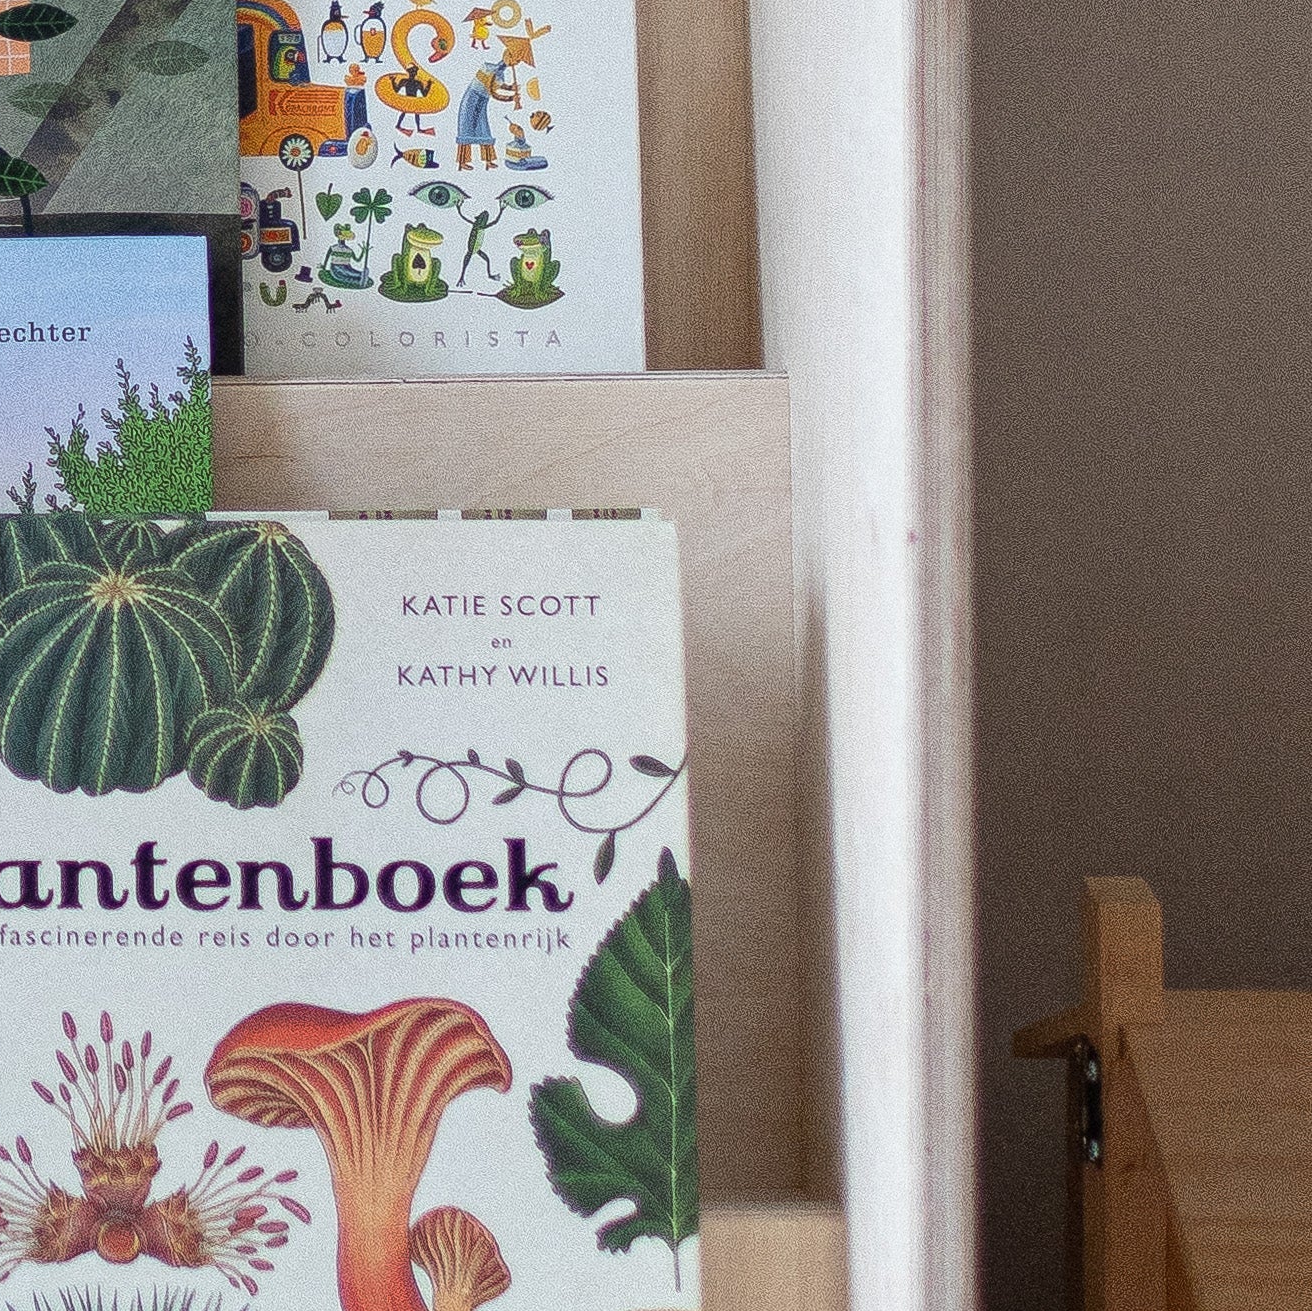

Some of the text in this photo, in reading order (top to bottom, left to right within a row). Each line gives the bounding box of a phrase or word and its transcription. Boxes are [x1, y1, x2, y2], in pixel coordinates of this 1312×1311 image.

[301, 330, 562, 347] COLORISTA
[402, 594, 601, 617] KATIE SCOTT
[490, 635, 513, 650] en
[397, 663, 611, 688] KATHY WILLIS
[197, 924, 255, 948] reis
[265, 924, 335, 950] door
[349, 926, 399, 950] het
[409, 924, 572, 955] plantenrijk
